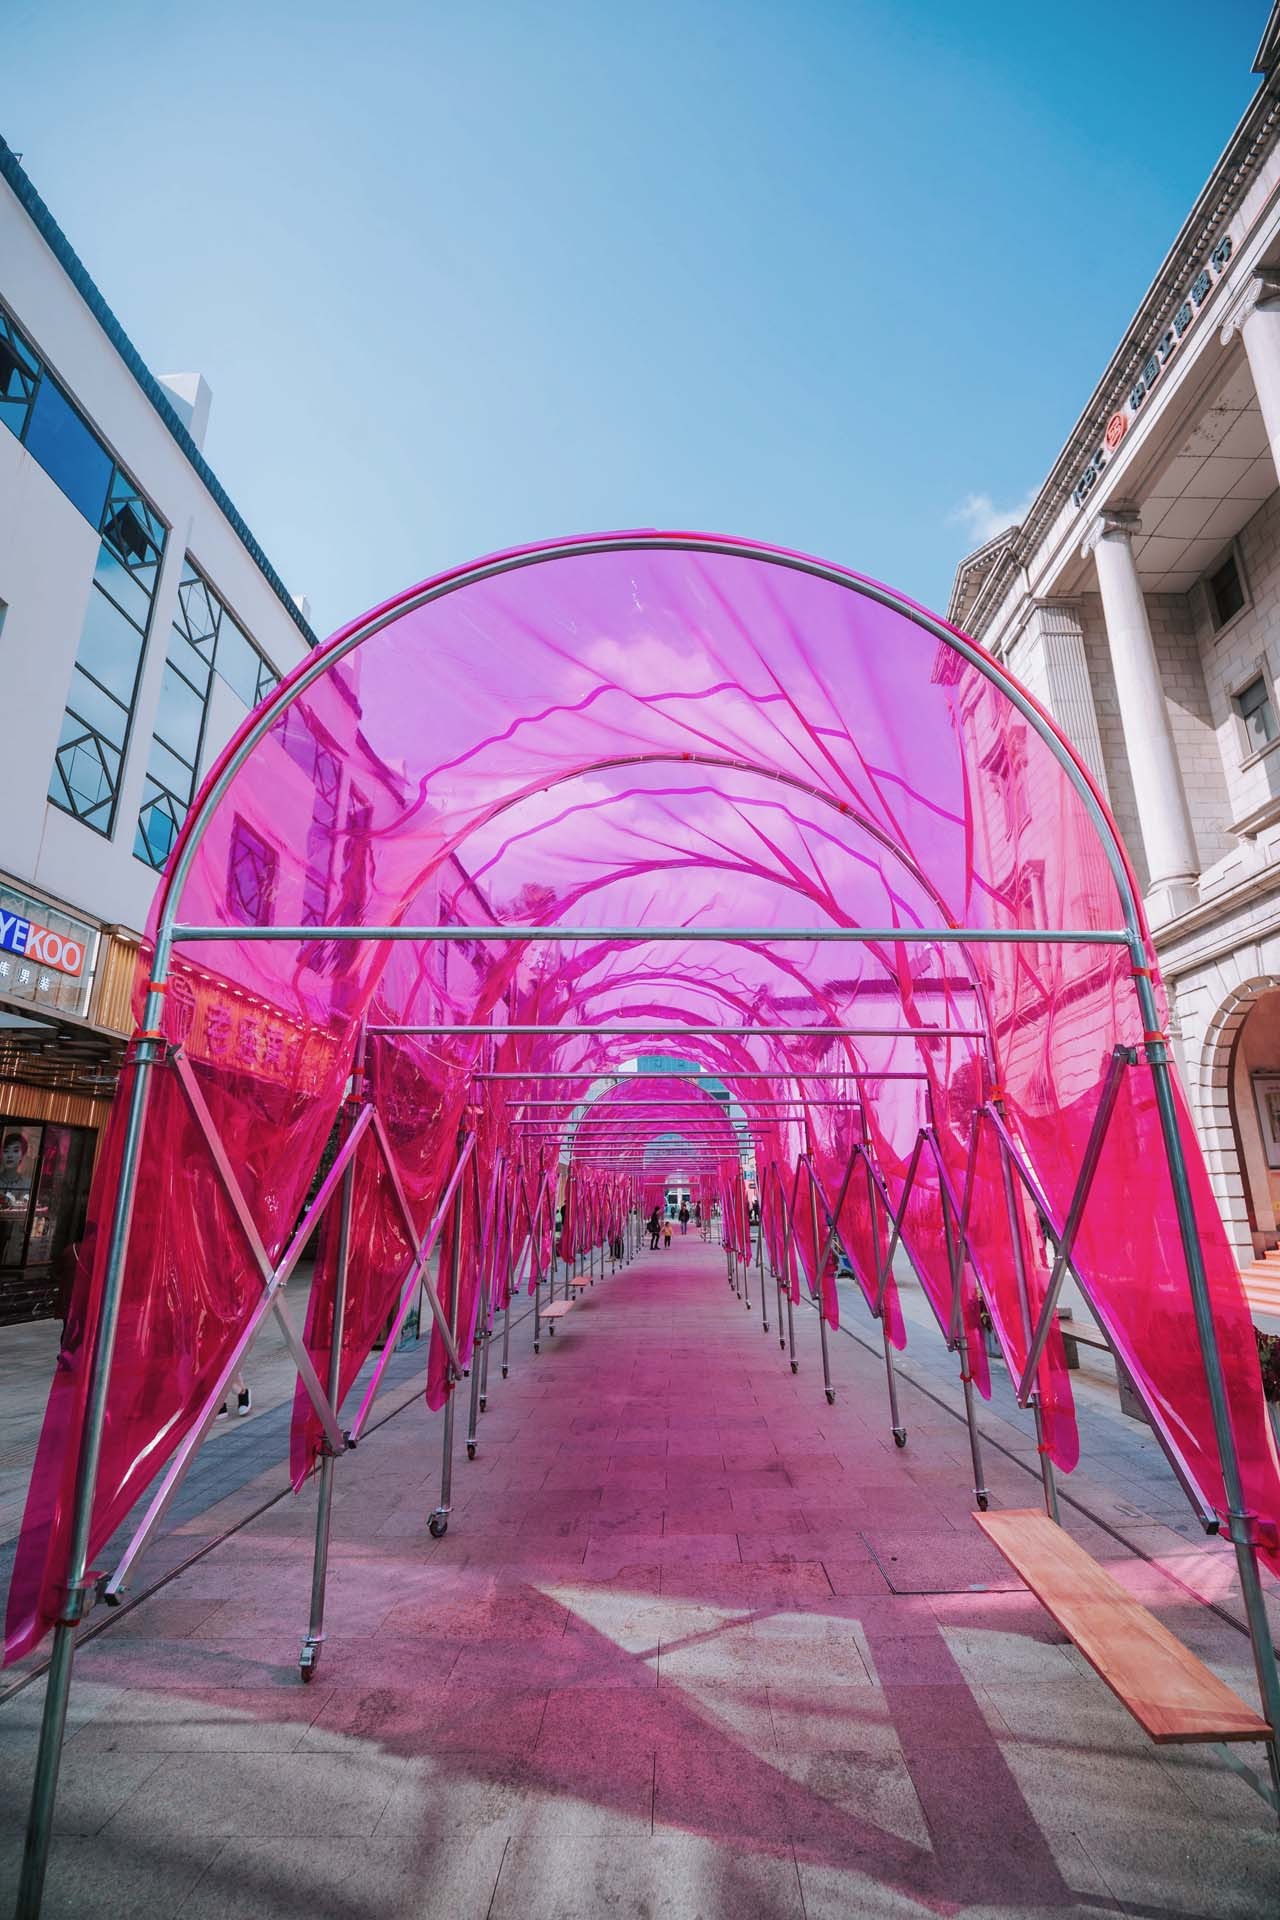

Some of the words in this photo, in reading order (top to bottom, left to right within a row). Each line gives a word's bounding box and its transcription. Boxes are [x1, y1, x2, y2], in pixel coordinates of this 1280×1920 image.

[1130, 235, 1233, 411] 中国工商银行
[1072, 447, 1106, 507] ICBC
